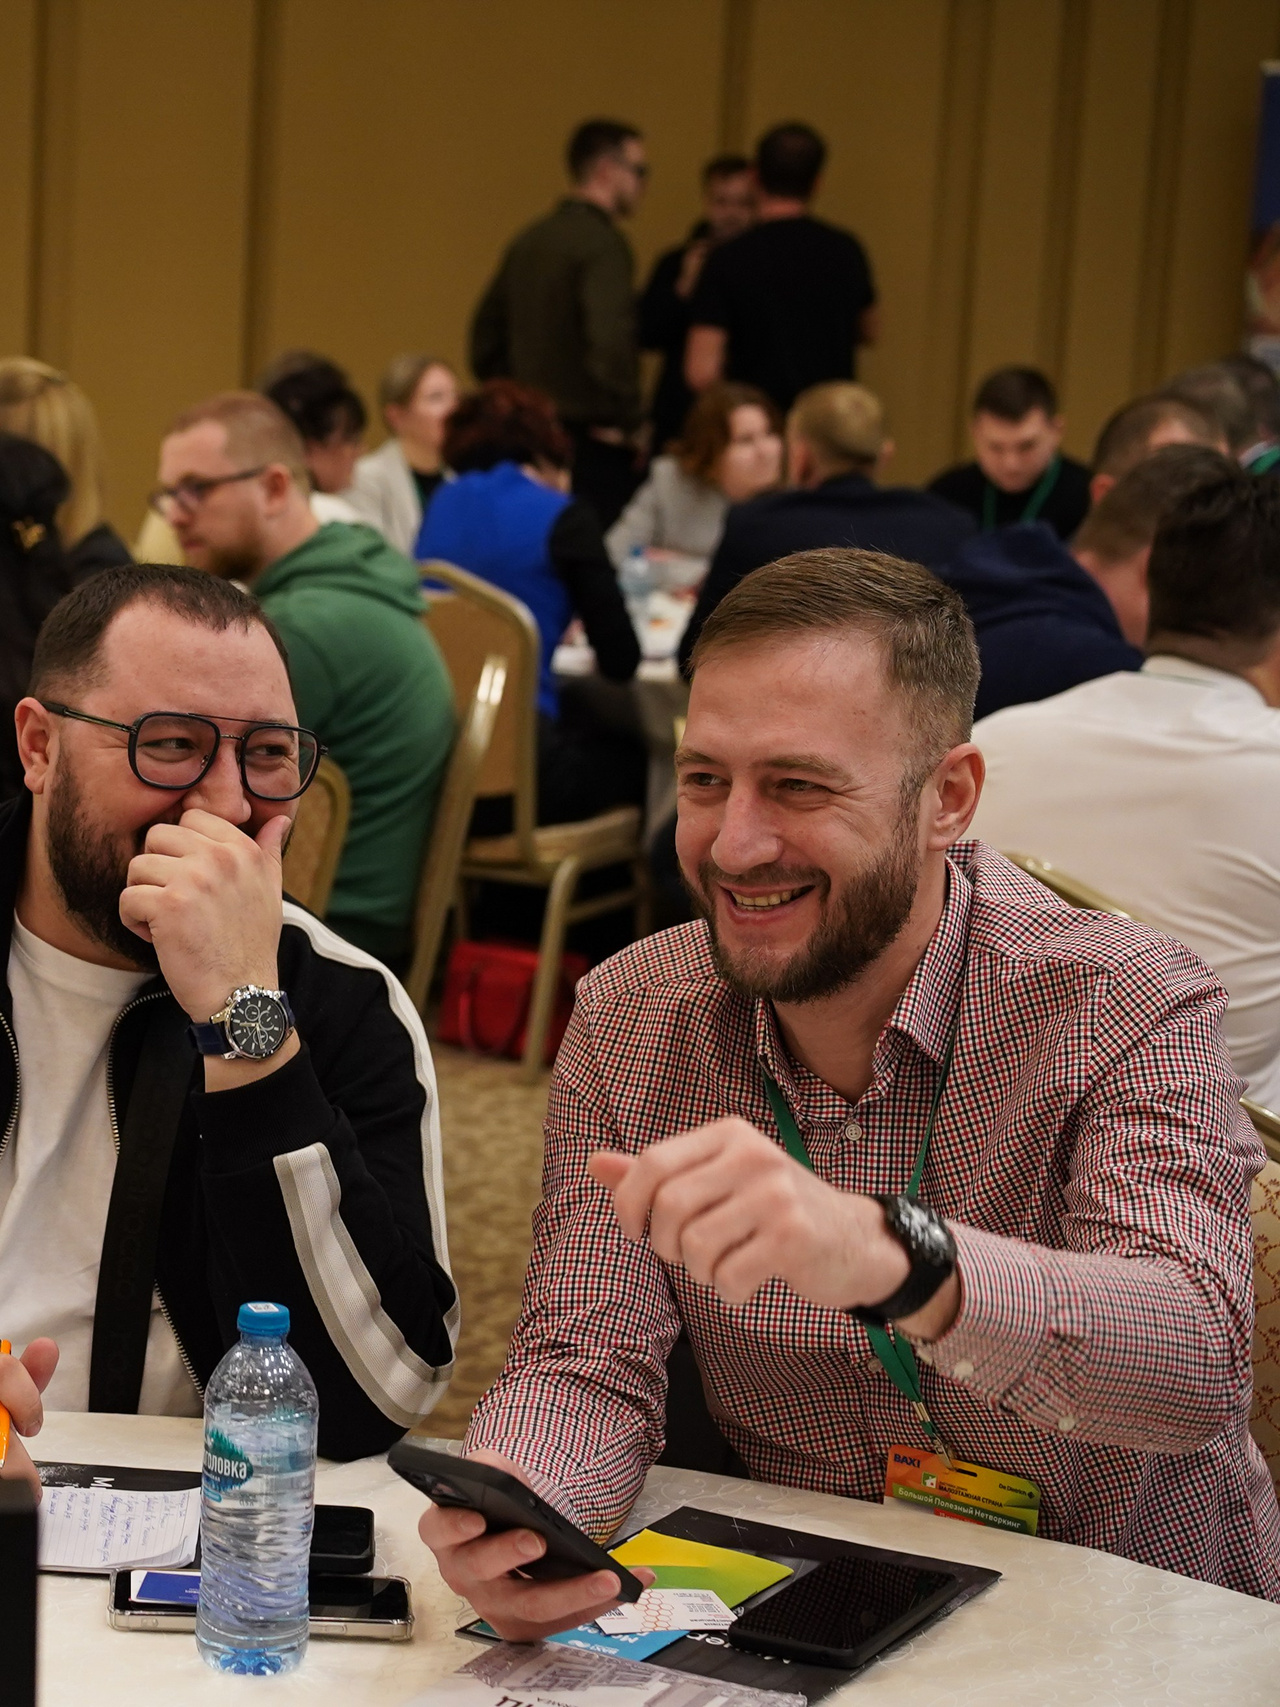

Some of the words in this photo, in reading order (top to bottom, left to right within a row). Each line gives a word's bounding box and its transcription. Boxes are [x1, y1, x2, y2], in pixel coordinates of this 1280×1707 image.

[203, 1450, 247, 1480] головка
[893, 1453, 921, 1469] BAXI
[898, 1487, 934, 1504] Большой
[934, 1495, 974, 1515] Полезный
[974, 1509, 1021, 1529] Нетворкинг
[938, 1485, 981, 1502] МАЛОЭТАЖНАЯ
[981, 1498, 1003, 1508] СТРАНА
